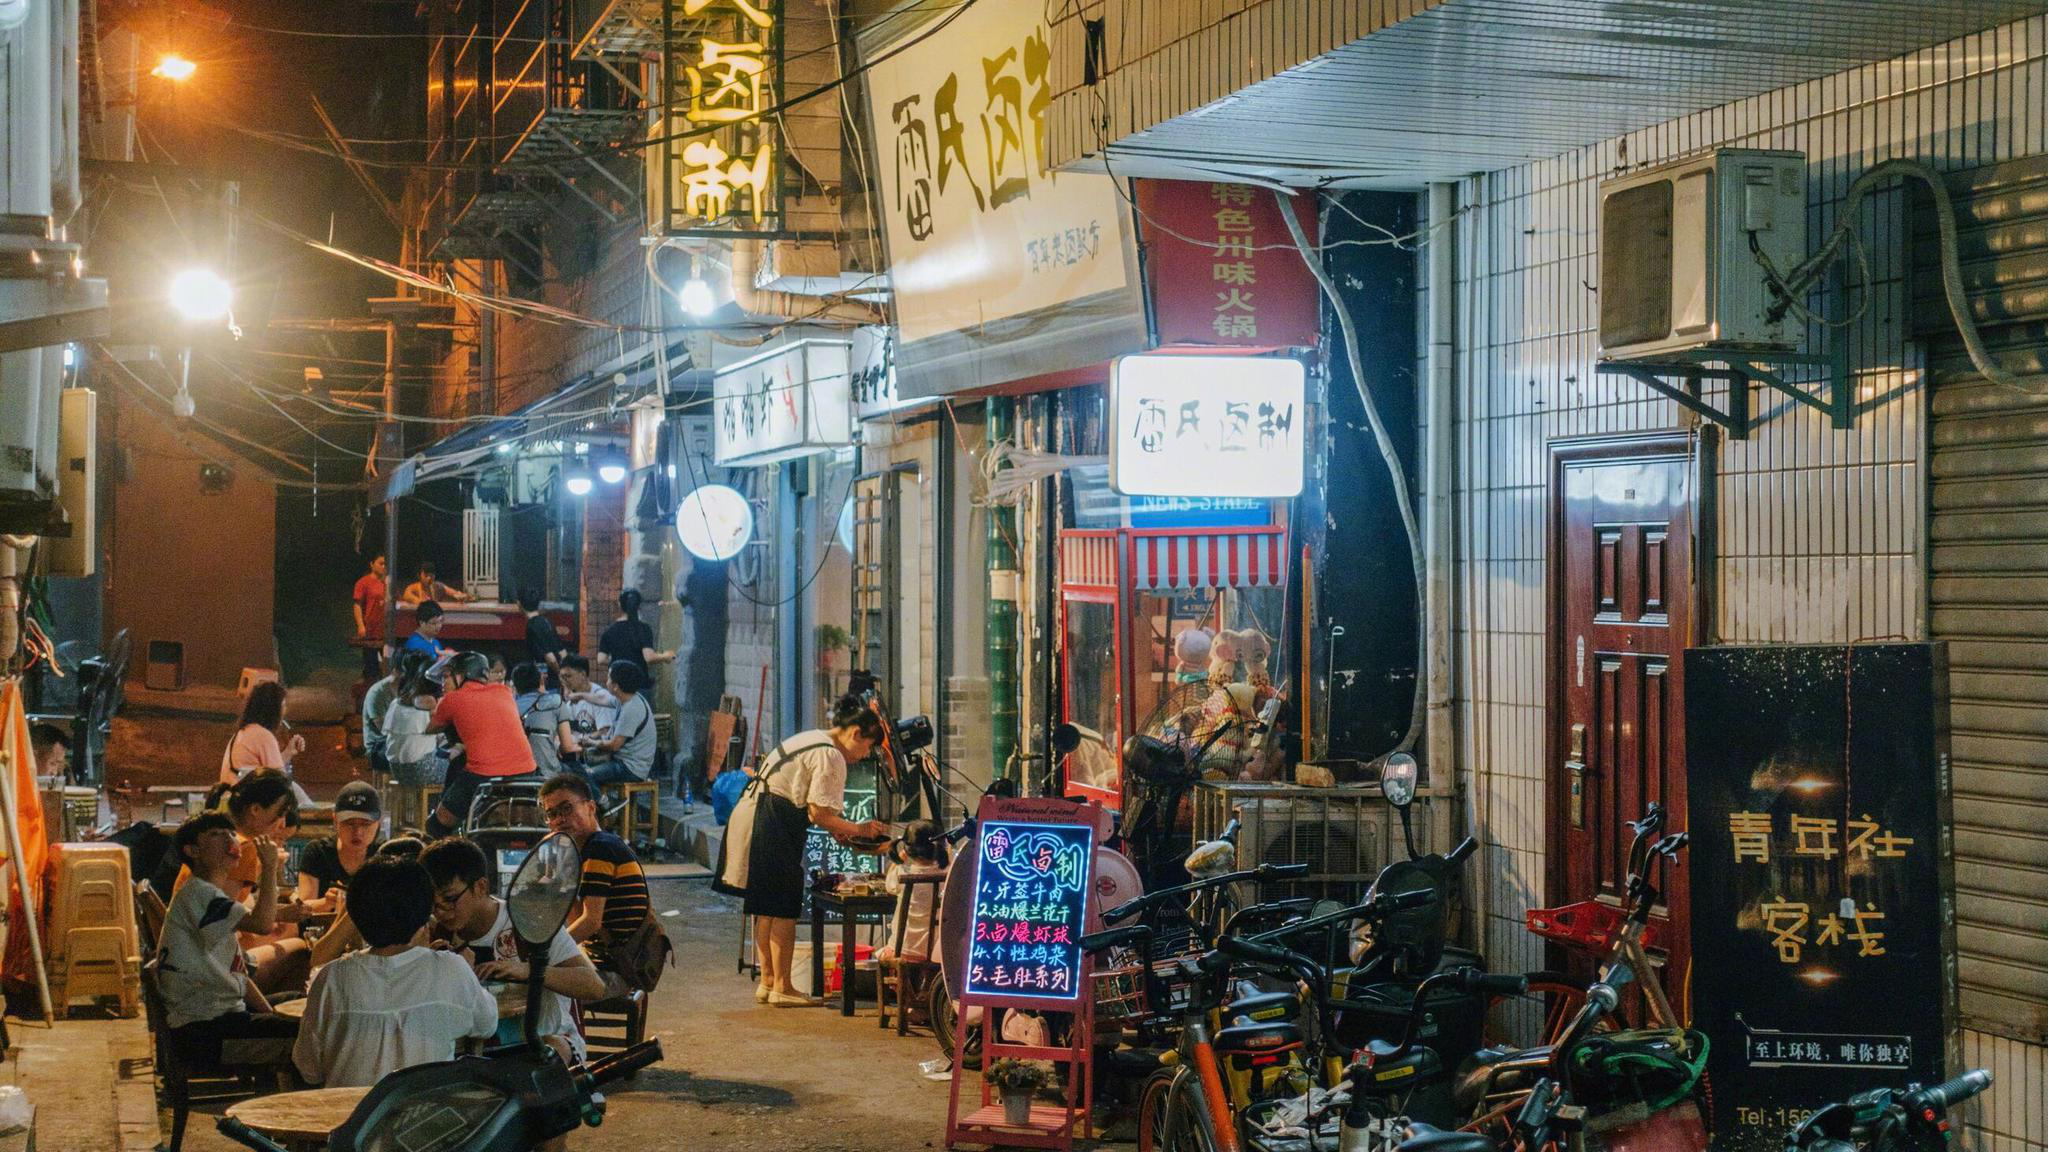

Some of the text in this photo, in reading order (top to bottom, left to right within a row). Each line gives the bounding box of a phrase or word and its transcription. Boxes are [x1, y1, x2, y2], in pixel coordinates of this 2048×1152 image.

[1211, 183, 1257, 338] 特色川味火锅
[987, 831, 1074, 886] 雷氏卤制
[1729, 810, 1914, 864] 青年社
[1760, 895, 1886, 964] 客栈
